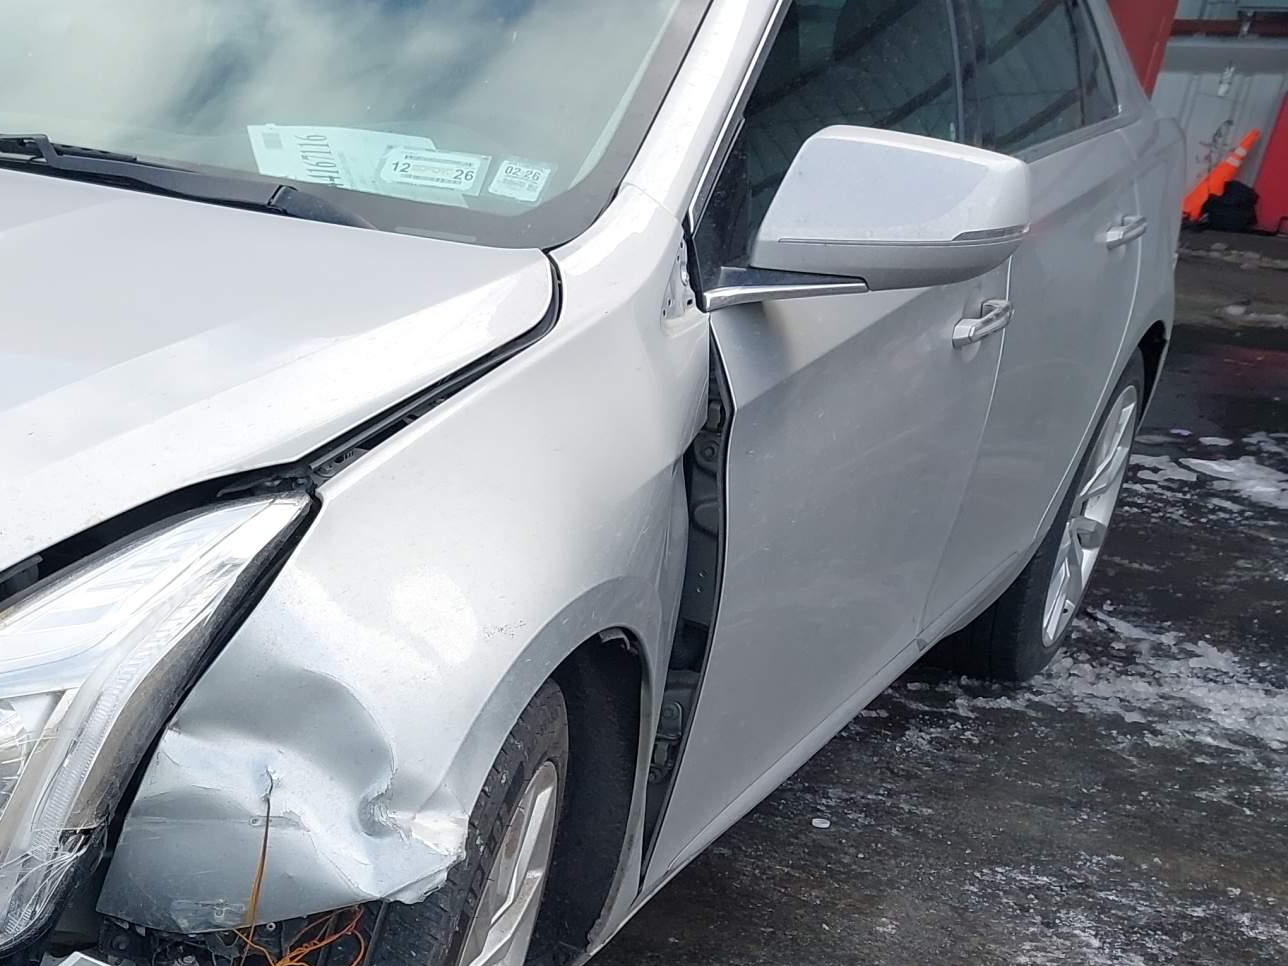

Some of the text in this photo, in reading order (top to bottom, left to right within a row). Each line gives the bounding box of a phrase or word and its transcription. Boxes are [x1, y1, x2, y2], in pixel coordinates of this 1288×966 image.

[294, 135, 344, 187] 4167116
[392, 161, 411, 173] 12
[453, 168, 474, 182] 26
